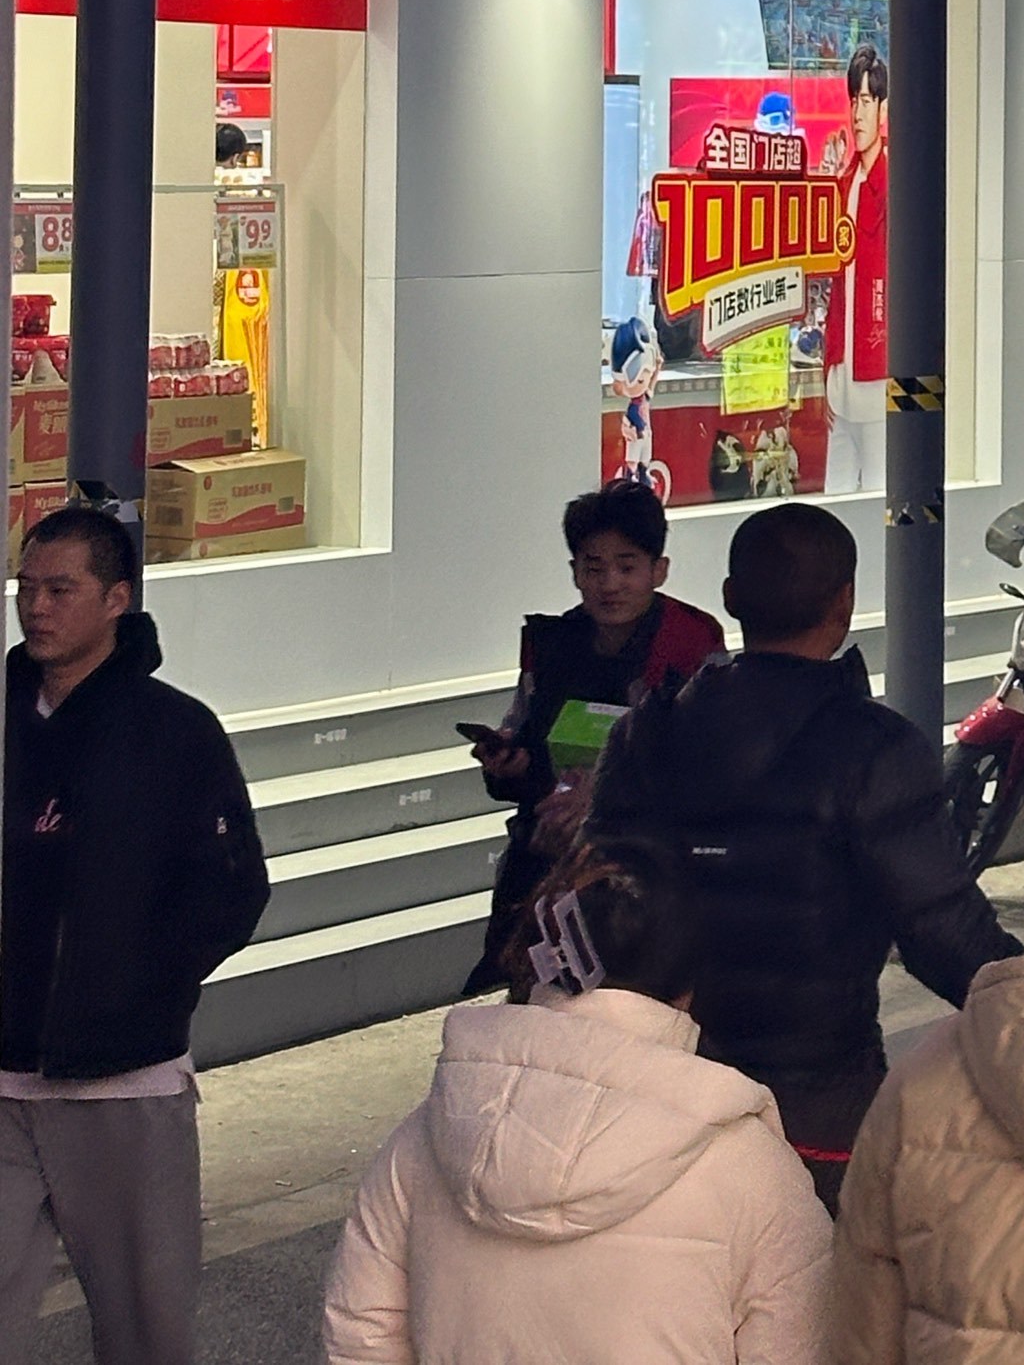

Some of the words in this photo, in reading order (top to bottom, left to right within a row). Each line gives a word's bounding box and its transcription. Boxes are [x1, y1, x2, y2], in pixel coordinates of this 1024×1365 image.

[709, 277, 798, 331] 门店数行业第一
